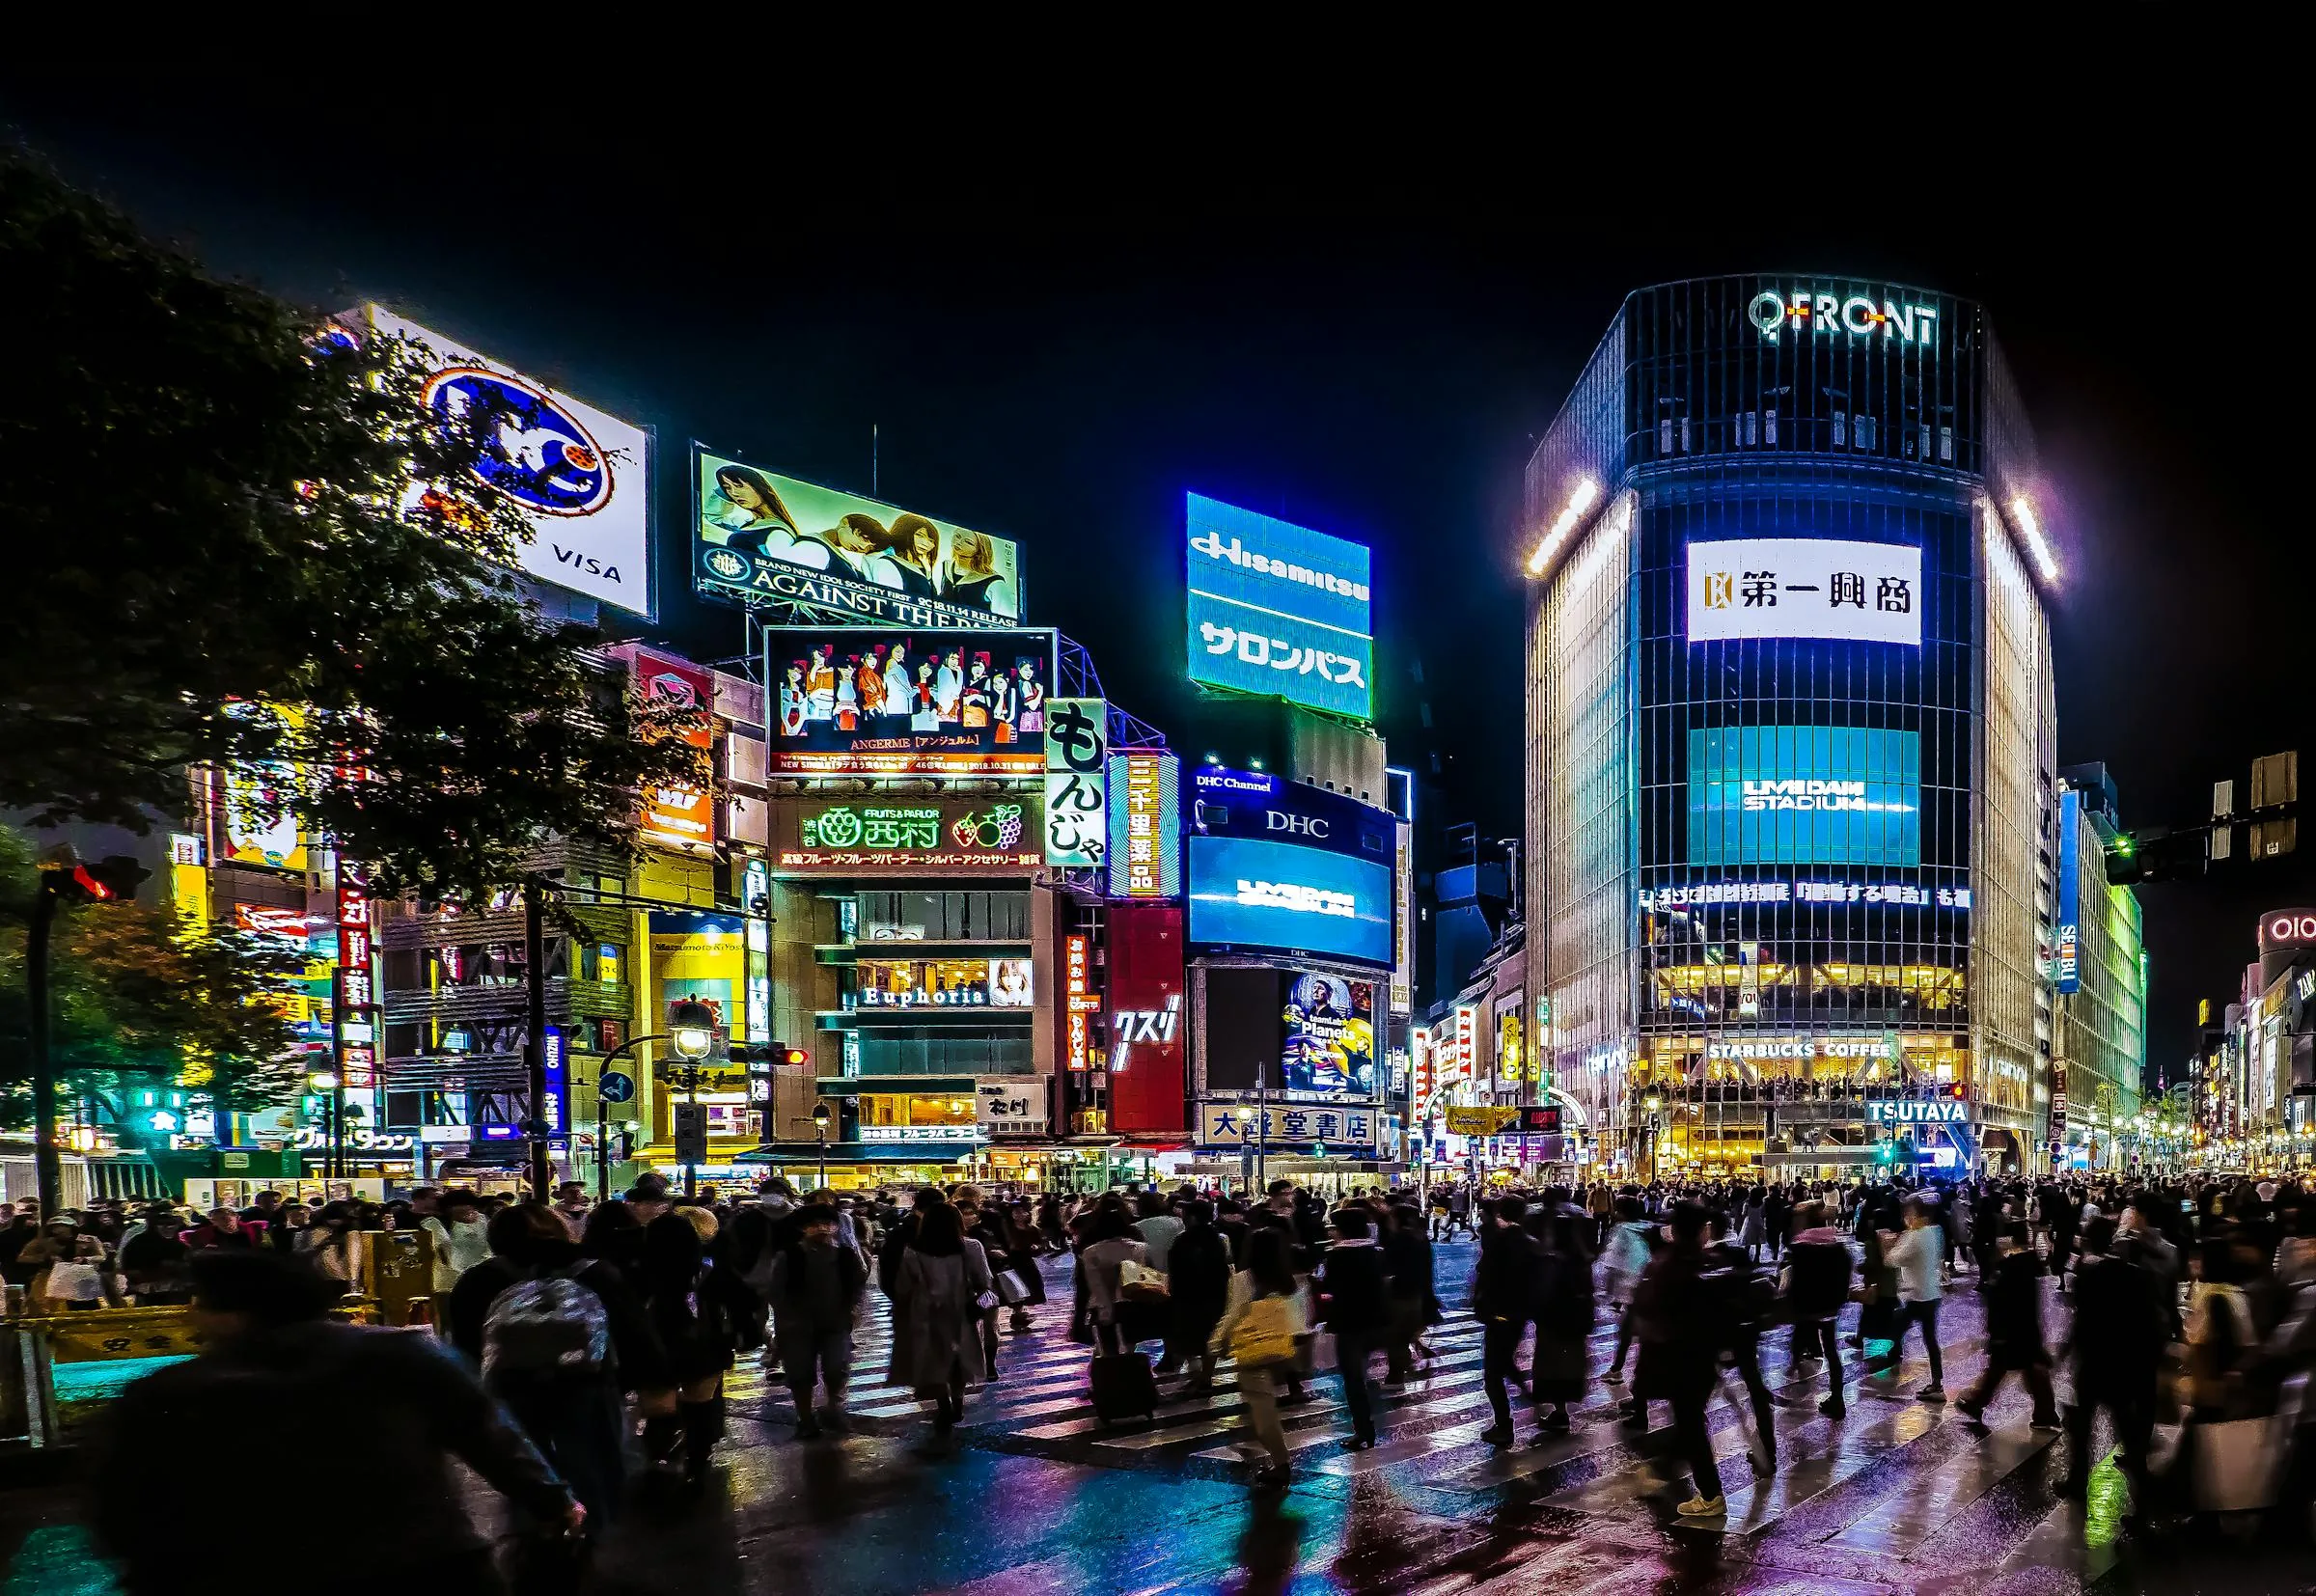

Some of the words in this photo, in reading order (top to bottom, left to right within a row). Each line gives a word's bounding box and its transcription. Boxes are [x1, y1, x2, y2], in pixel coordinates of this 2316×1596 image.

[1749, 291, 1937, 344] QFRONT
[551, 543, 622, 584] VISA
[1190, 532, 1370, 601] Hisamitsu
[755, 558, 791, 572] BRAND
[793, 567, 818, 579] NEW
[971, 611, 1018, 626] RELEASE
[1741, 570, 1912, 614] 第一興商
[893, 602, 951, 627] THE
[1199, 621, 1365, 689] サロンパス
[850, 737, 911, 751] ANGERME
[1050, 702, 1104, 864] もんじゃ
[1197, 775, 1223, 787] DHC
[1224, 777, 1271, 792] Channel
[1743, 795, 1866, 811] STADIUM
[864, 821, 938, 849] 西村
[1266, 811, 1329, 838] DHC
[1290, 949, 1310, 957] DHC
[2060, 924, 2077, 980] SEIBU
[863, 986, 985, 1005] Euphoria
[1112, 994, 1180, 1072] クスリ
[1301, 1021, 1356, 1040] Planets
[1310, 1014, 1342, 1026] teamLab
[546, 1033, 560, 1070] MIZUHO
[1708, 1043, 1815, 1059] STARBUCKS
[1824, 1043, 1891, 1059] COFFEE
[1868, 1102, 1967, 1122] TSUTAYA
